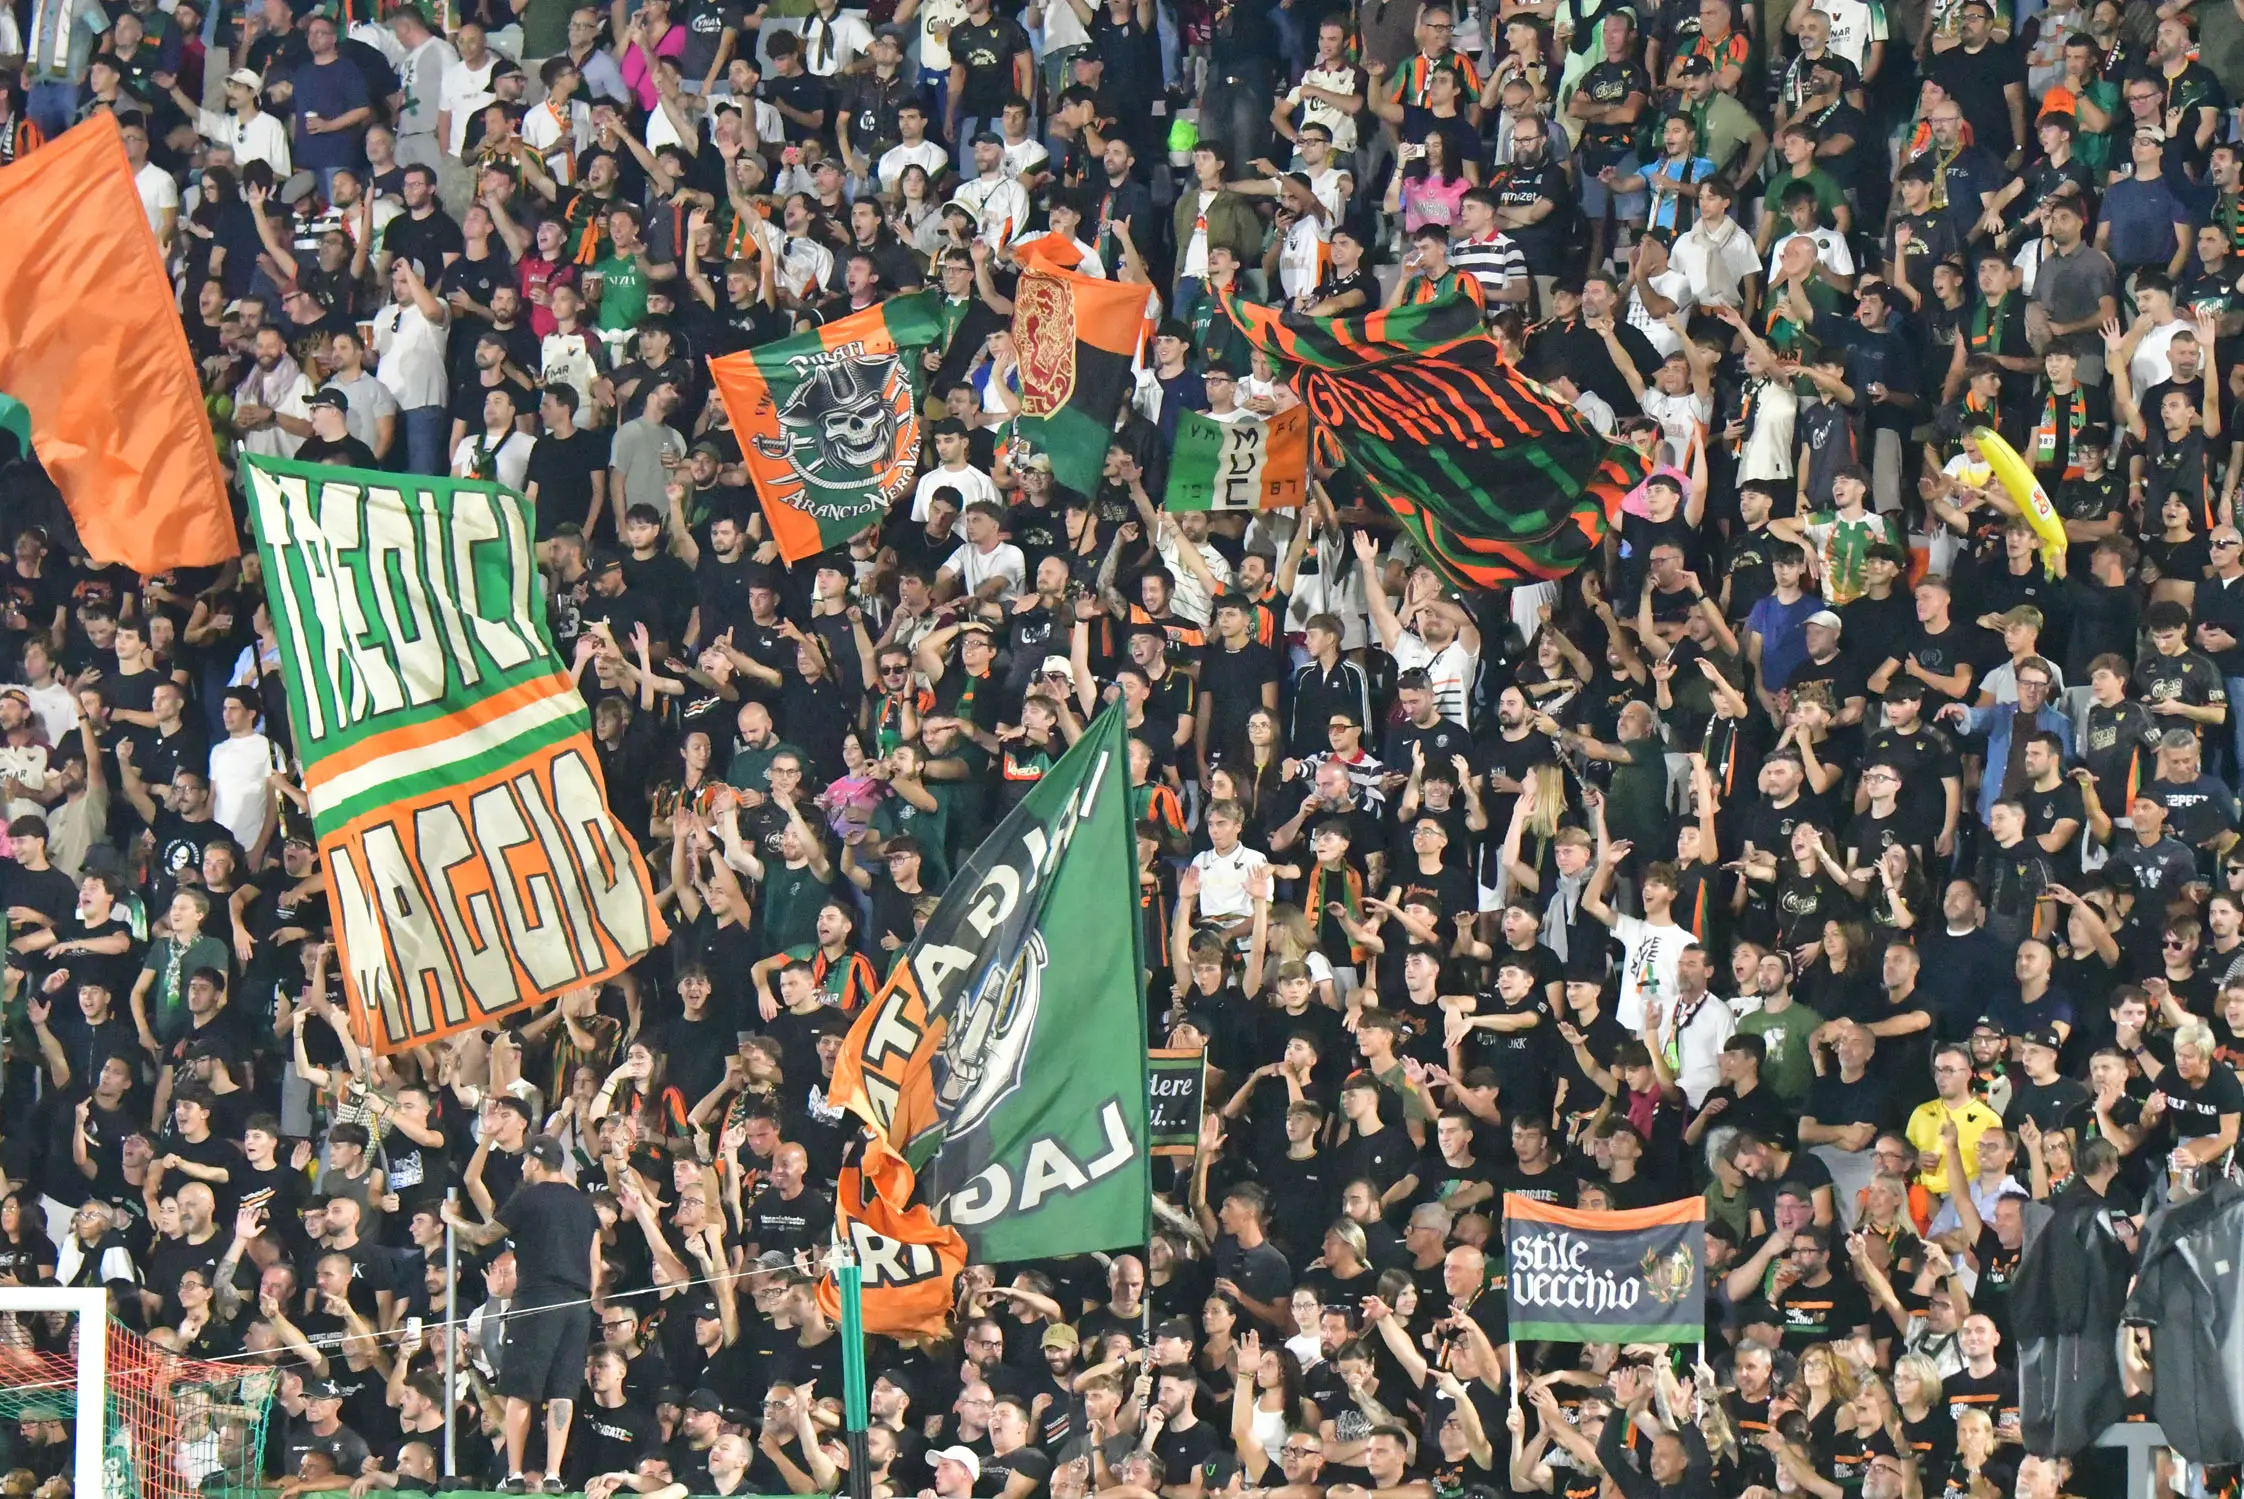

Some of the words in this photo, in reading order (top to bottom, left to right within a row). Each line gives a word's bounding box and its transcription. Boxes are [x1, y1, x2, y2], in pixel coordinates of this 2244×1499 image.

[1830, 28, 1850, 39] NAR
[785, 340, 866, 378] PIRATI
[248, 463, 550, 741] TREDICI
[329, 749, 653, 1044] MAGGIO
